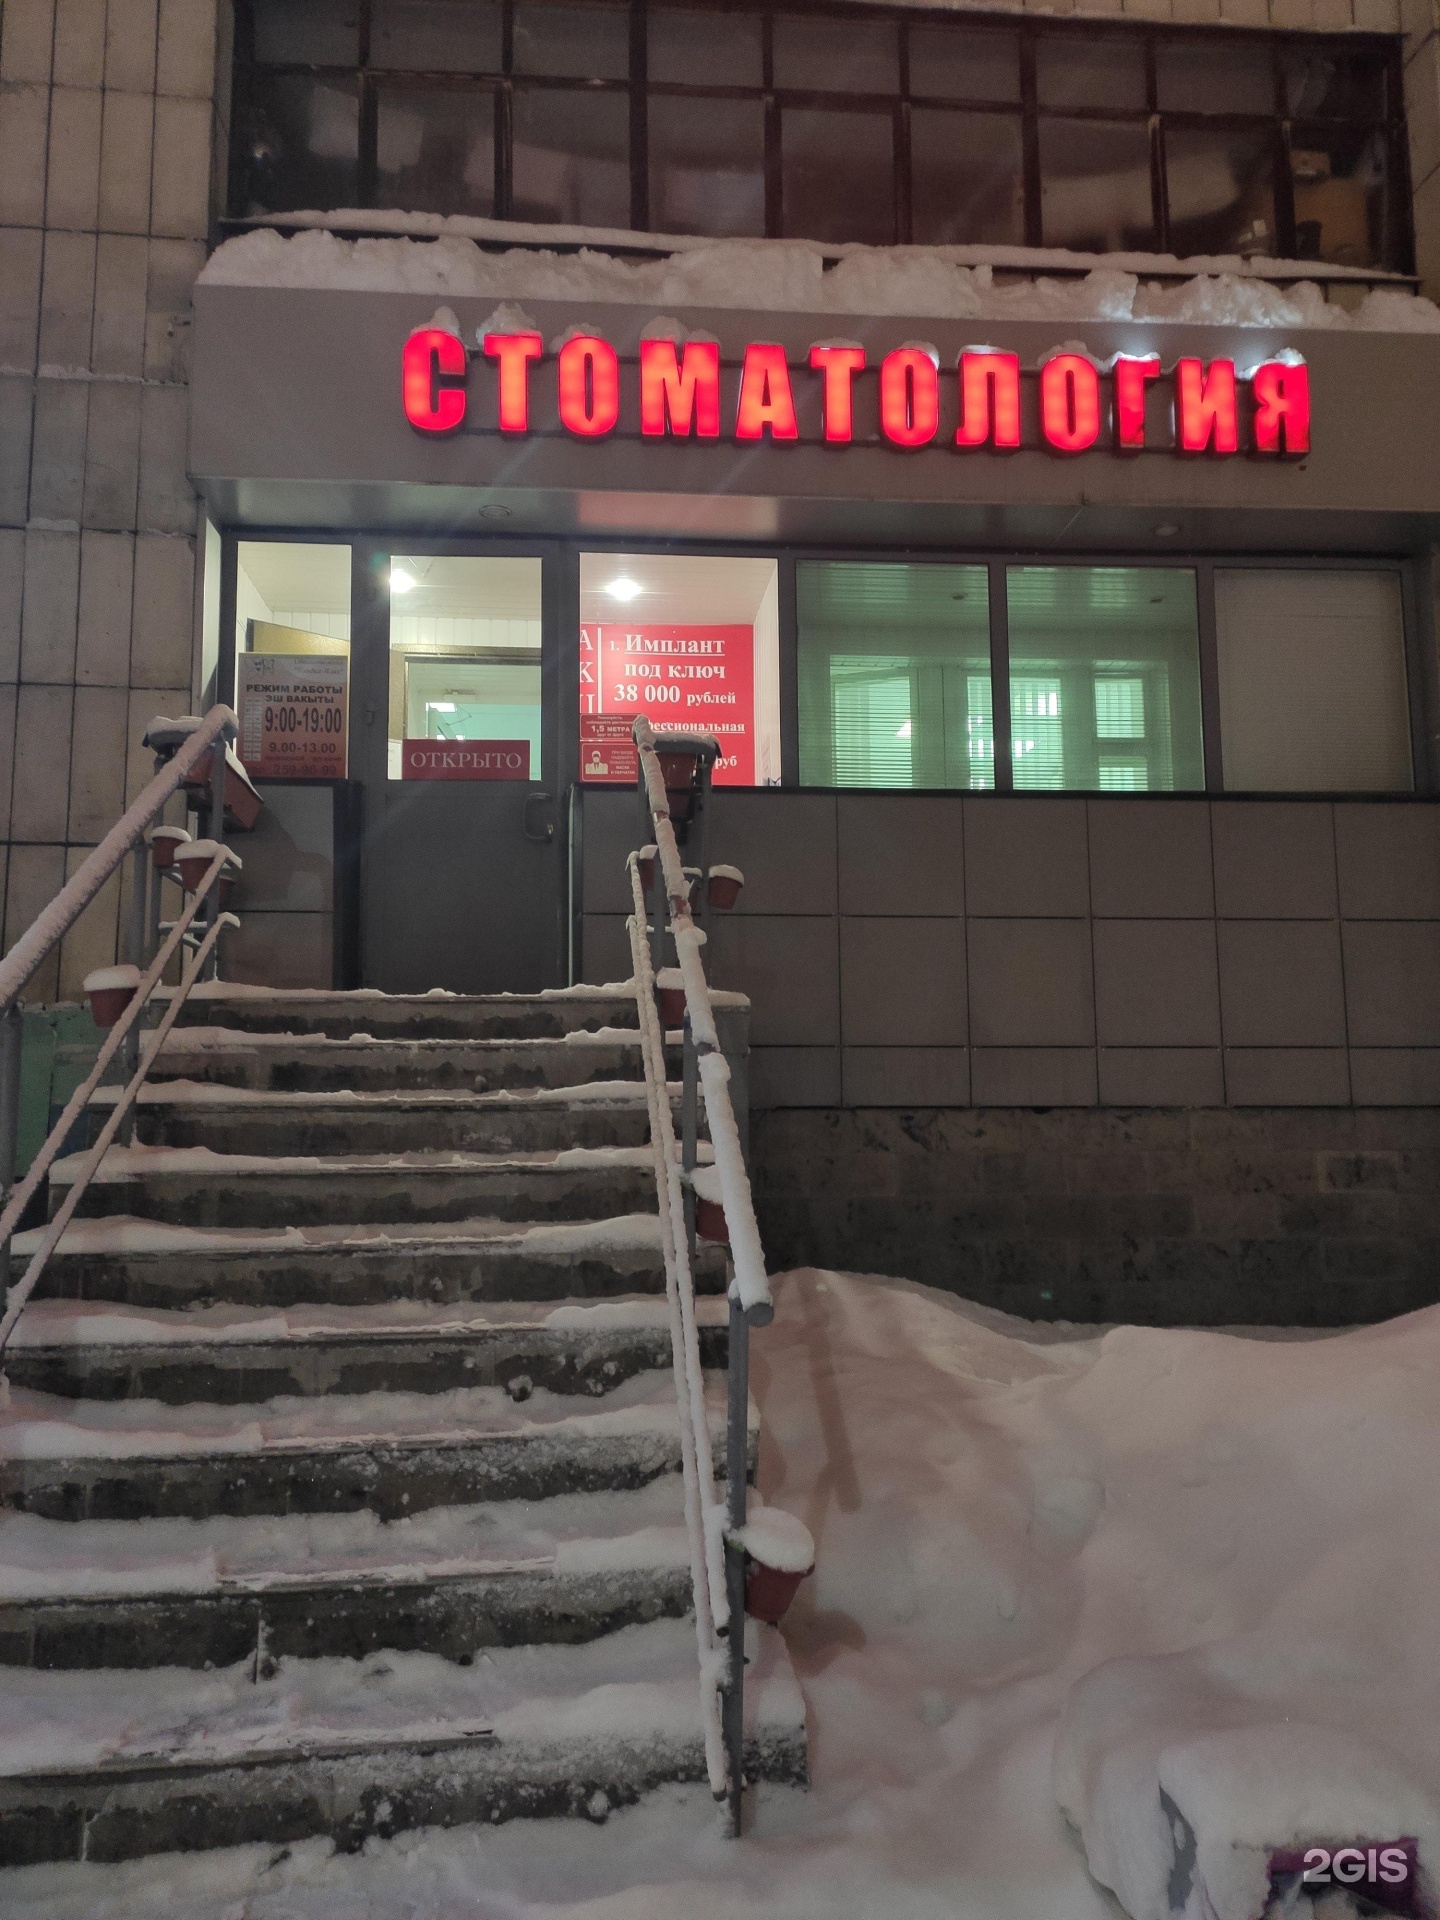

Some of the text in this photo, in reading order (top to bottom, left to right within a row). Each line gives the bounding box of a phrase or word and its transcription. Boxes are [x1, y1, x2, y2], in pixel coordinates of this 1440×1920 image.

[402, 330, 1311, 454] СТОМАТОЛОГИЯ
[624, 634, 726, 653] Имплант
[624, 663, 726, 680] под ключ
[246, 684, 343, 694] РЕЖИМ РАБОТЫ
[613, 683, 736, 706] 38 000 рублей
[286, 695, 335, 704] ВАКЫТЫ
[265, 706, 342, 734] 9:00-19:00
[410, 752, 522, 768] ОТКРЫТО
